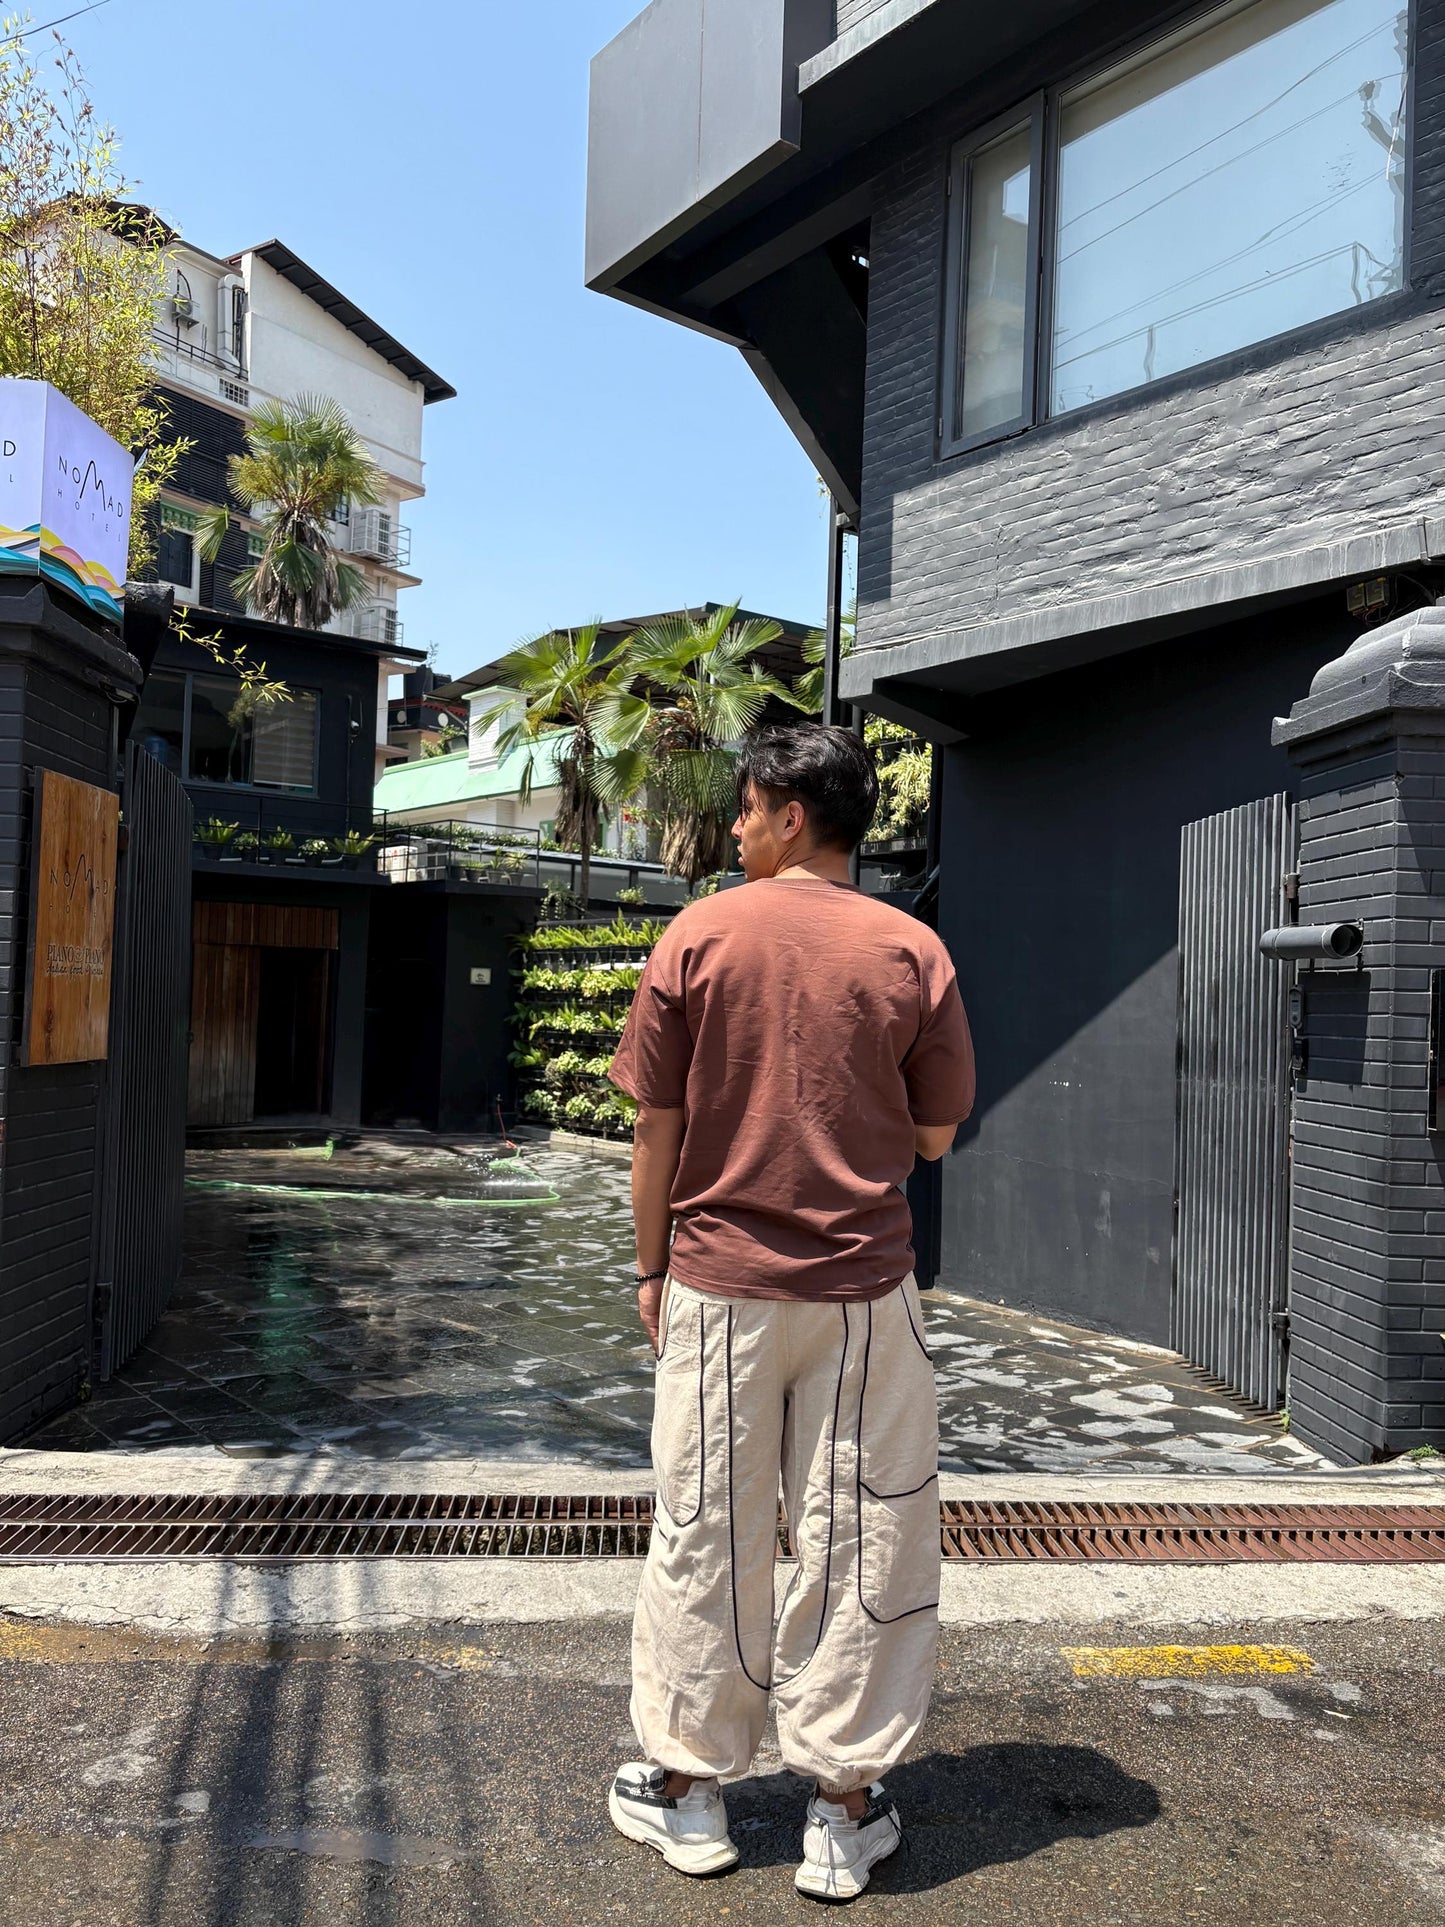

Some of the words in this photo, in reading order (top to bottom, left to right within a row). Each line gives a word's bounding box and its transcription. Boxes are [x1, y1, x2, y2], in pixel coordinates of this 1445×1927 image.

[58, 455, 123, 518] NOMAD
[57, 488, 121, 542] HOTEL
[49, 853, 109, 901] NOMAD
[47, 944, 75, 963] PIANO
